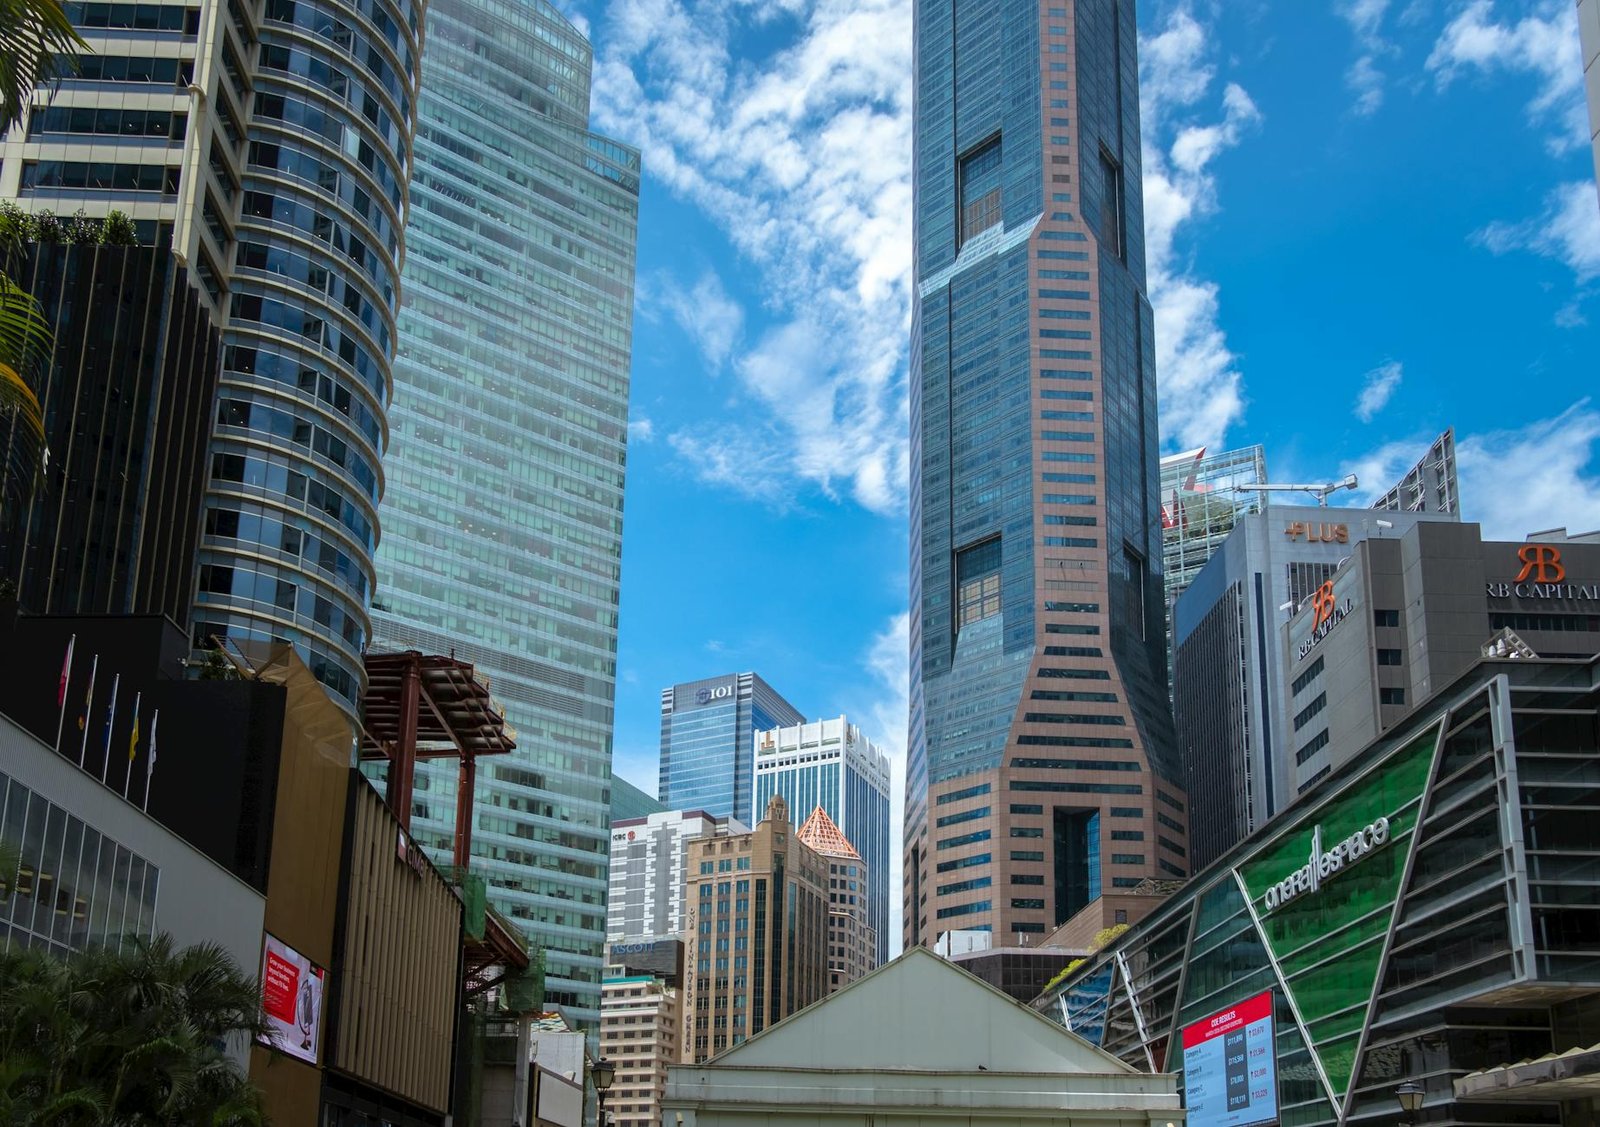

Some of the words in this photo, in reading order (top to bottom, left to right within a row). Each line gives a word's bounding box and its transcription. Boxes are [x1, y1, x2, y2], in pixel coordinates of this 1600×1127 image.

[1311, 598, 1353, 648] CAPITAL
[710, 685, 732, 700] IOI
[613, 943, 655, 954] ASCOTT
